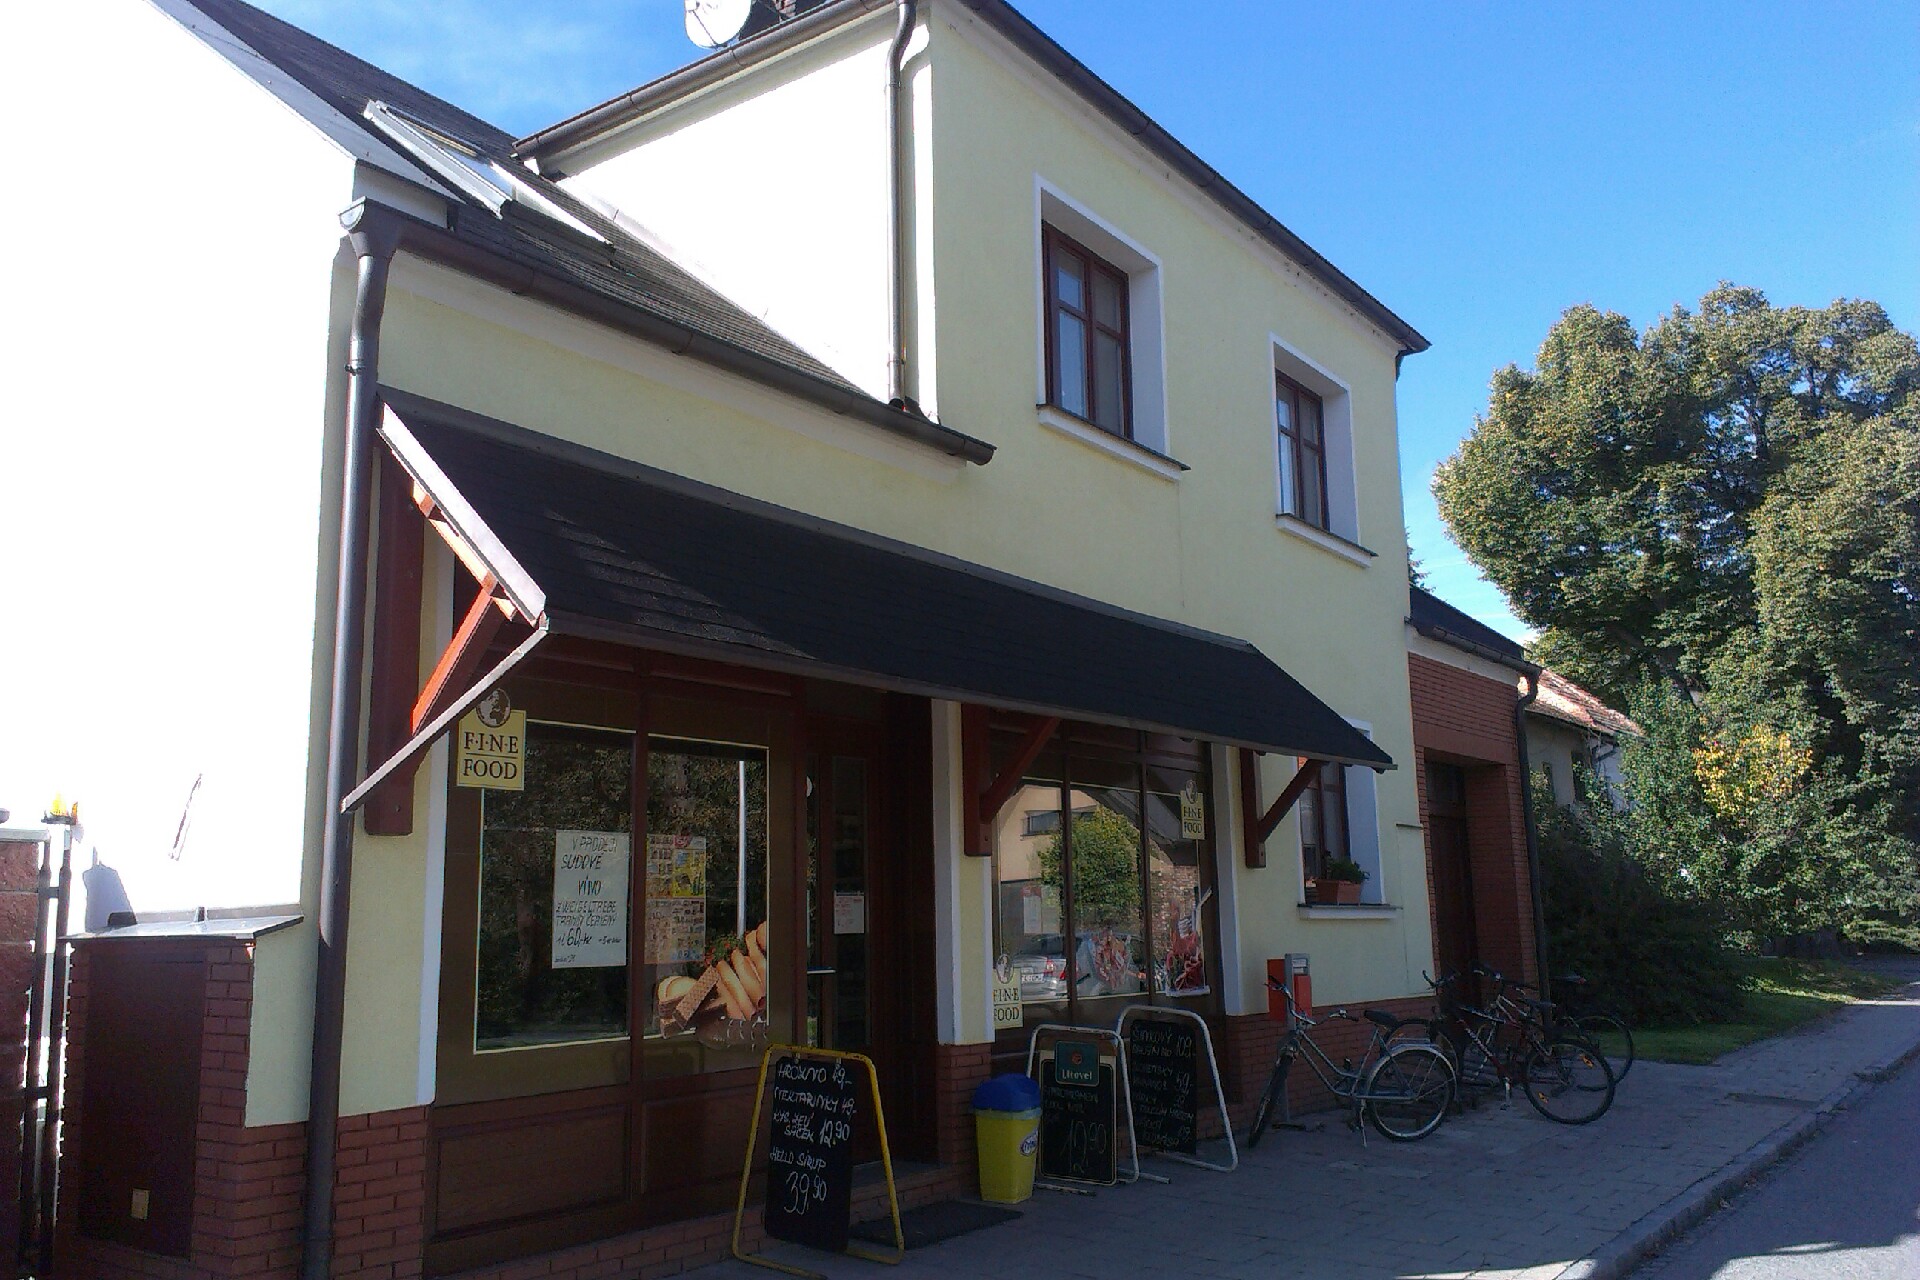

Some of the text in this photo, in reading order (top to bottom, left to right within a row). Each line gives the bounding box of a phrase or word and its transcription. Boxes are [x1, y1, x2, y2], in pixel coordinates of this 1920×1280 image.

[463, 758, 517, 780] FOOD
[1184, 821, 1203, 834] FOOD
[560, 852, 604, 870] SUDOVÉ
[578, 874, 602, 896] VÍNO
[1062, 1068, 1093, 1081] Litovel
[769, 1145, 795, 1165] HELLO
